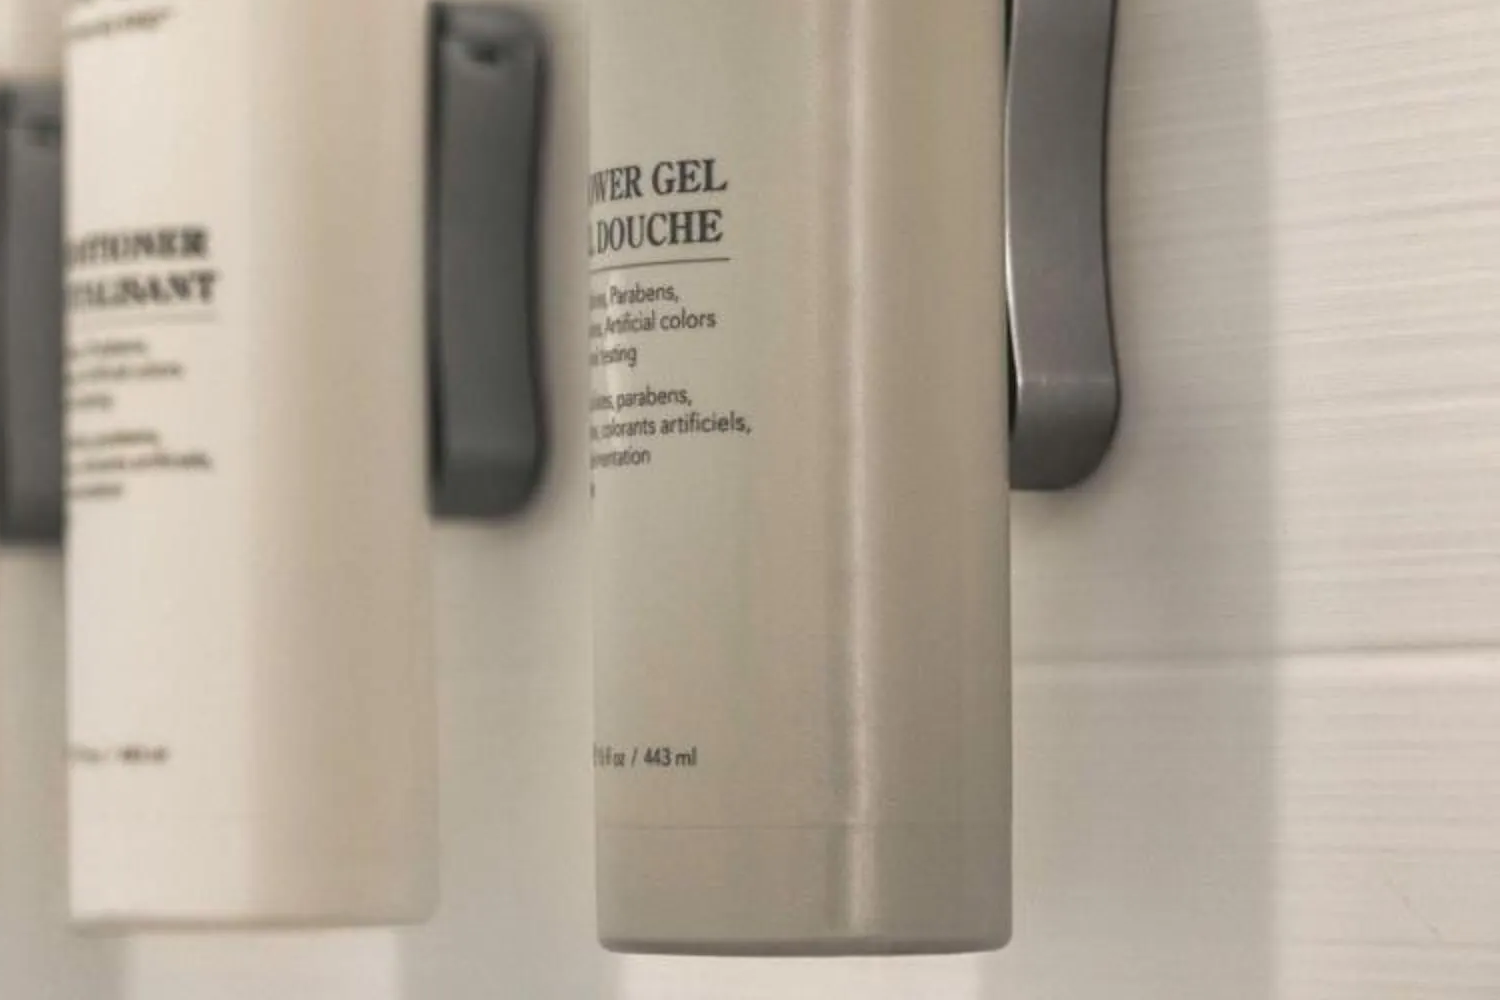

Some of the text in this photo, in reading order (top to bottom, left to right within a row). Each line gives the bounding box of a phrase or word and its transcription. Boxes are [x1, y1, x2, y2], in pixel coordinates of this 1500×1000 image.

[651, 158, 729, 196] GEL
[596, 209, 724, 255] DOUCHE
[609, 280, 680, 304] Parabens,
[659, 307, 717, 331] colors
[616, 385, 692, 413] parabens,
[660, 410, 753, 437] artificiels,
[643, 746, 672, 768] 443
[674, 745, 698, 767] ml
